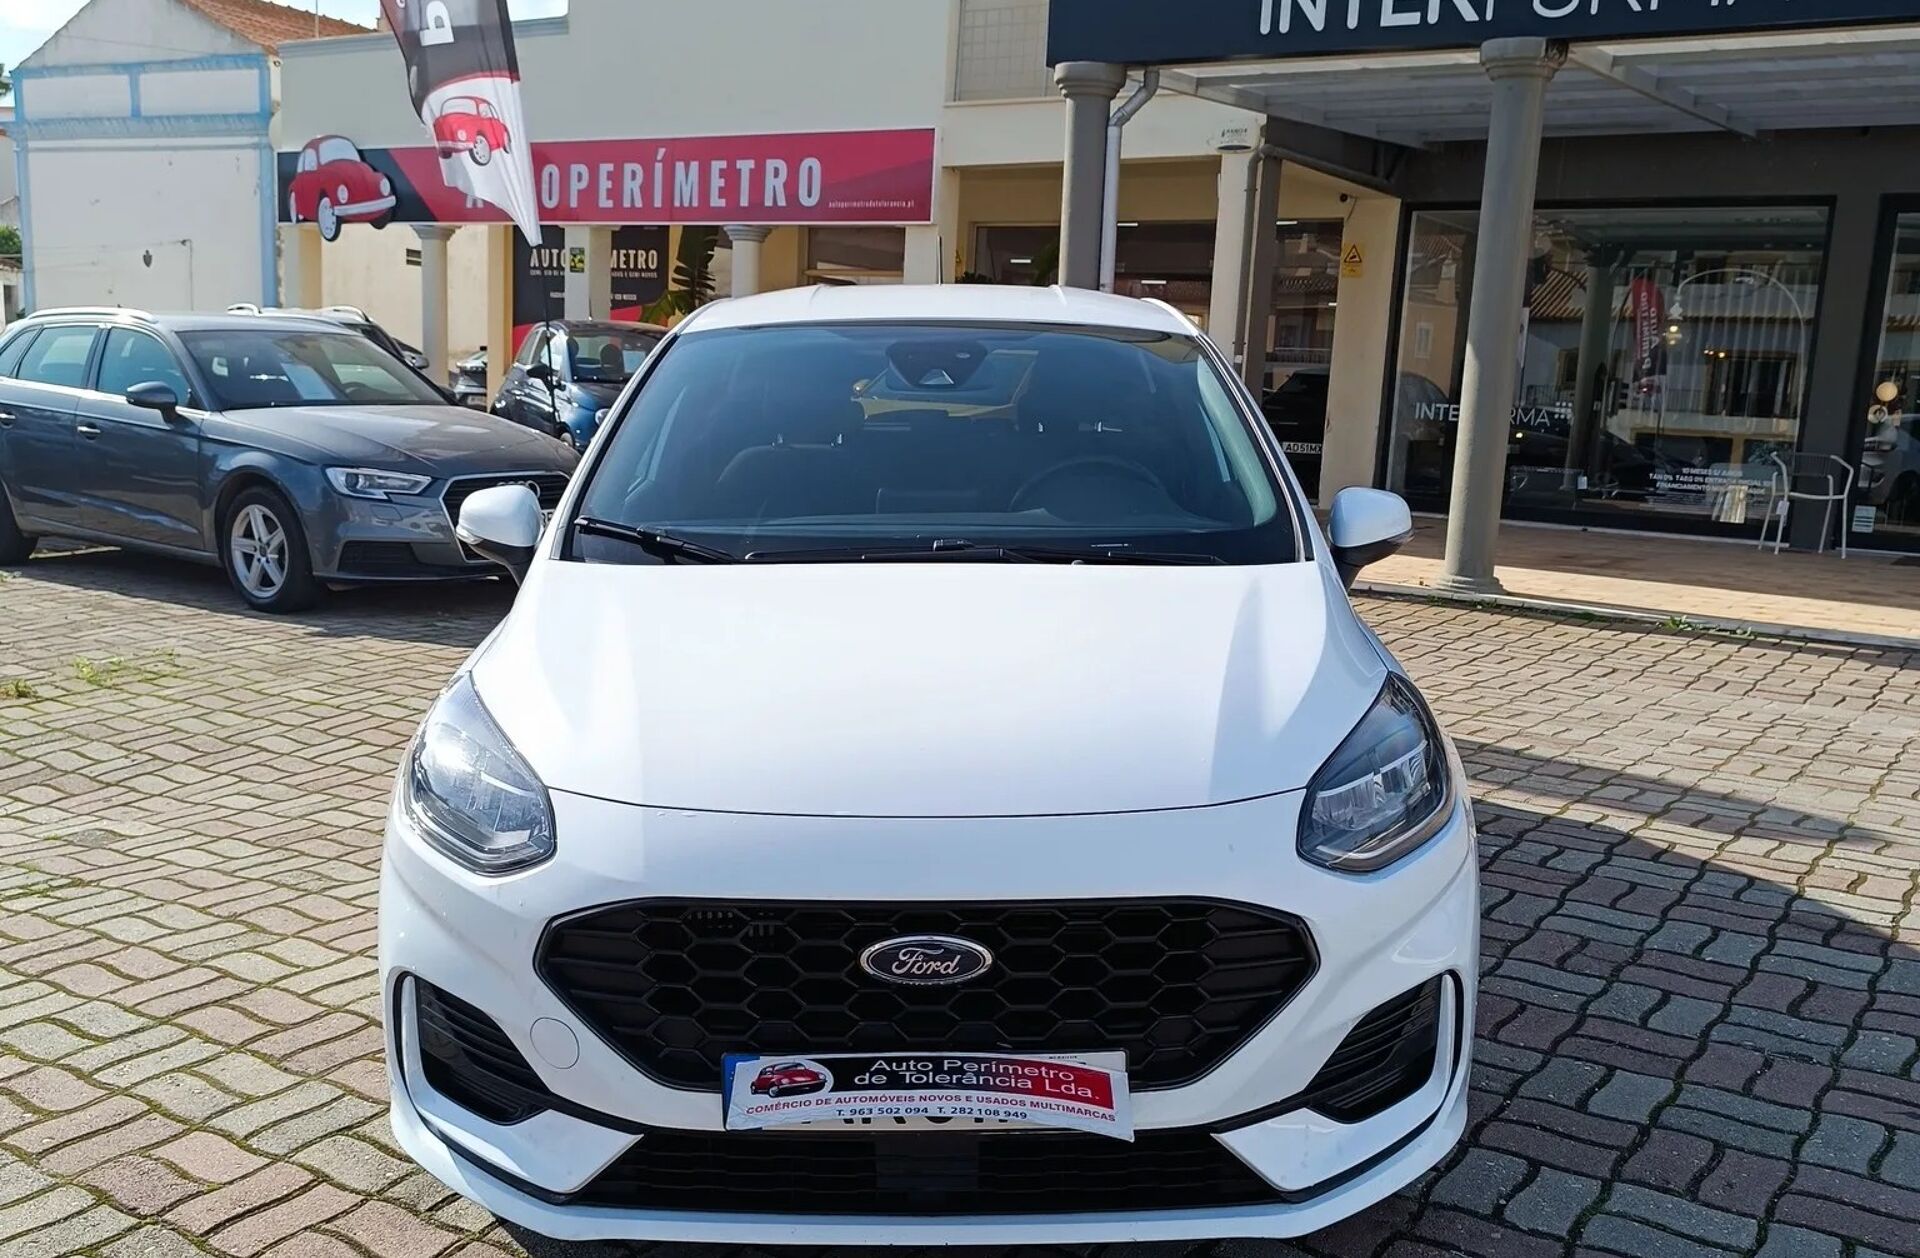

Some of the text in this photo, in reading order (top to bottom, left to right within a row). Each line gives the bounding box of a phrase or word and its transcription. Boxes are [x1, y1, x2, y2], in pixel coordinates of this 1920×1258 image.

[465, 148, 823, 209] OPERÍMETRO
[1414, 402, 1550, 426] INTERMA
[891, 947, 961, 975] Ford
[870, 1059, 1075, 1082] Auto Perímetro
[854, 1071, 1100, 1100] de Tolerância Lda.
[745, 1098, 812, 1115] COMÉRCIO
[815, 1098, 832, 1106] DE
[835, 1094, 915, 1105] AUTOMÓVEIS
[919, 1094, 962, 1102] NOVOS
[976, 1096, 1027, 1107] USADOS
[1029, 1101, 1116, 1122] MULTIMARCAS
[836, 1106, 1028, 1119] T. 963 502 094 T. 282 108 949
